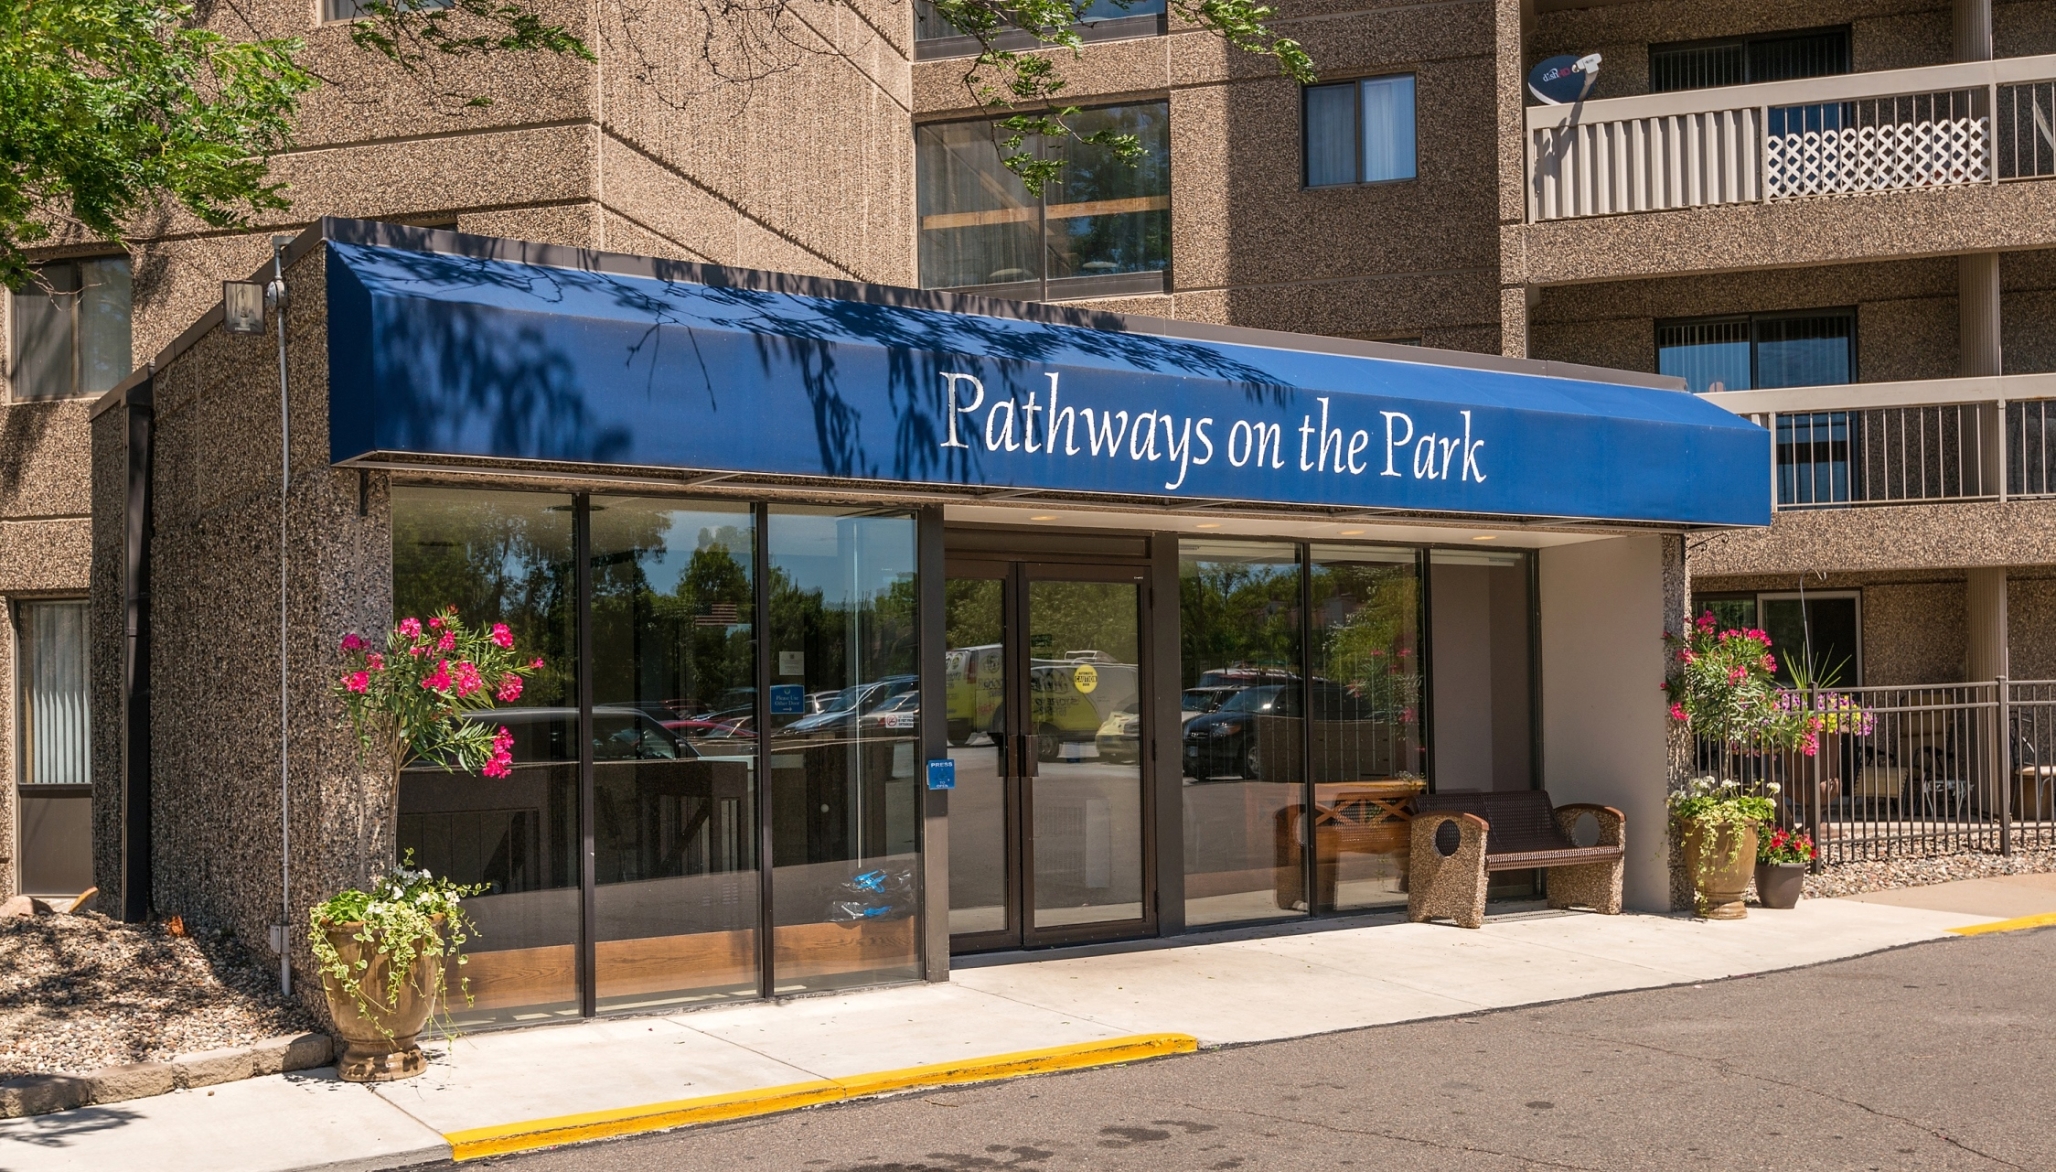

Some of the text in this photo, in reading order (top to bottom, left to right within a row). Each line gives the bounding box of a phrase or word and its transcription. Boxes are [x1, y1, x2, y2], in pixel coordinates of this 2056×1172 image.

[939, 371, 1488, 490] Pathways on the Park
